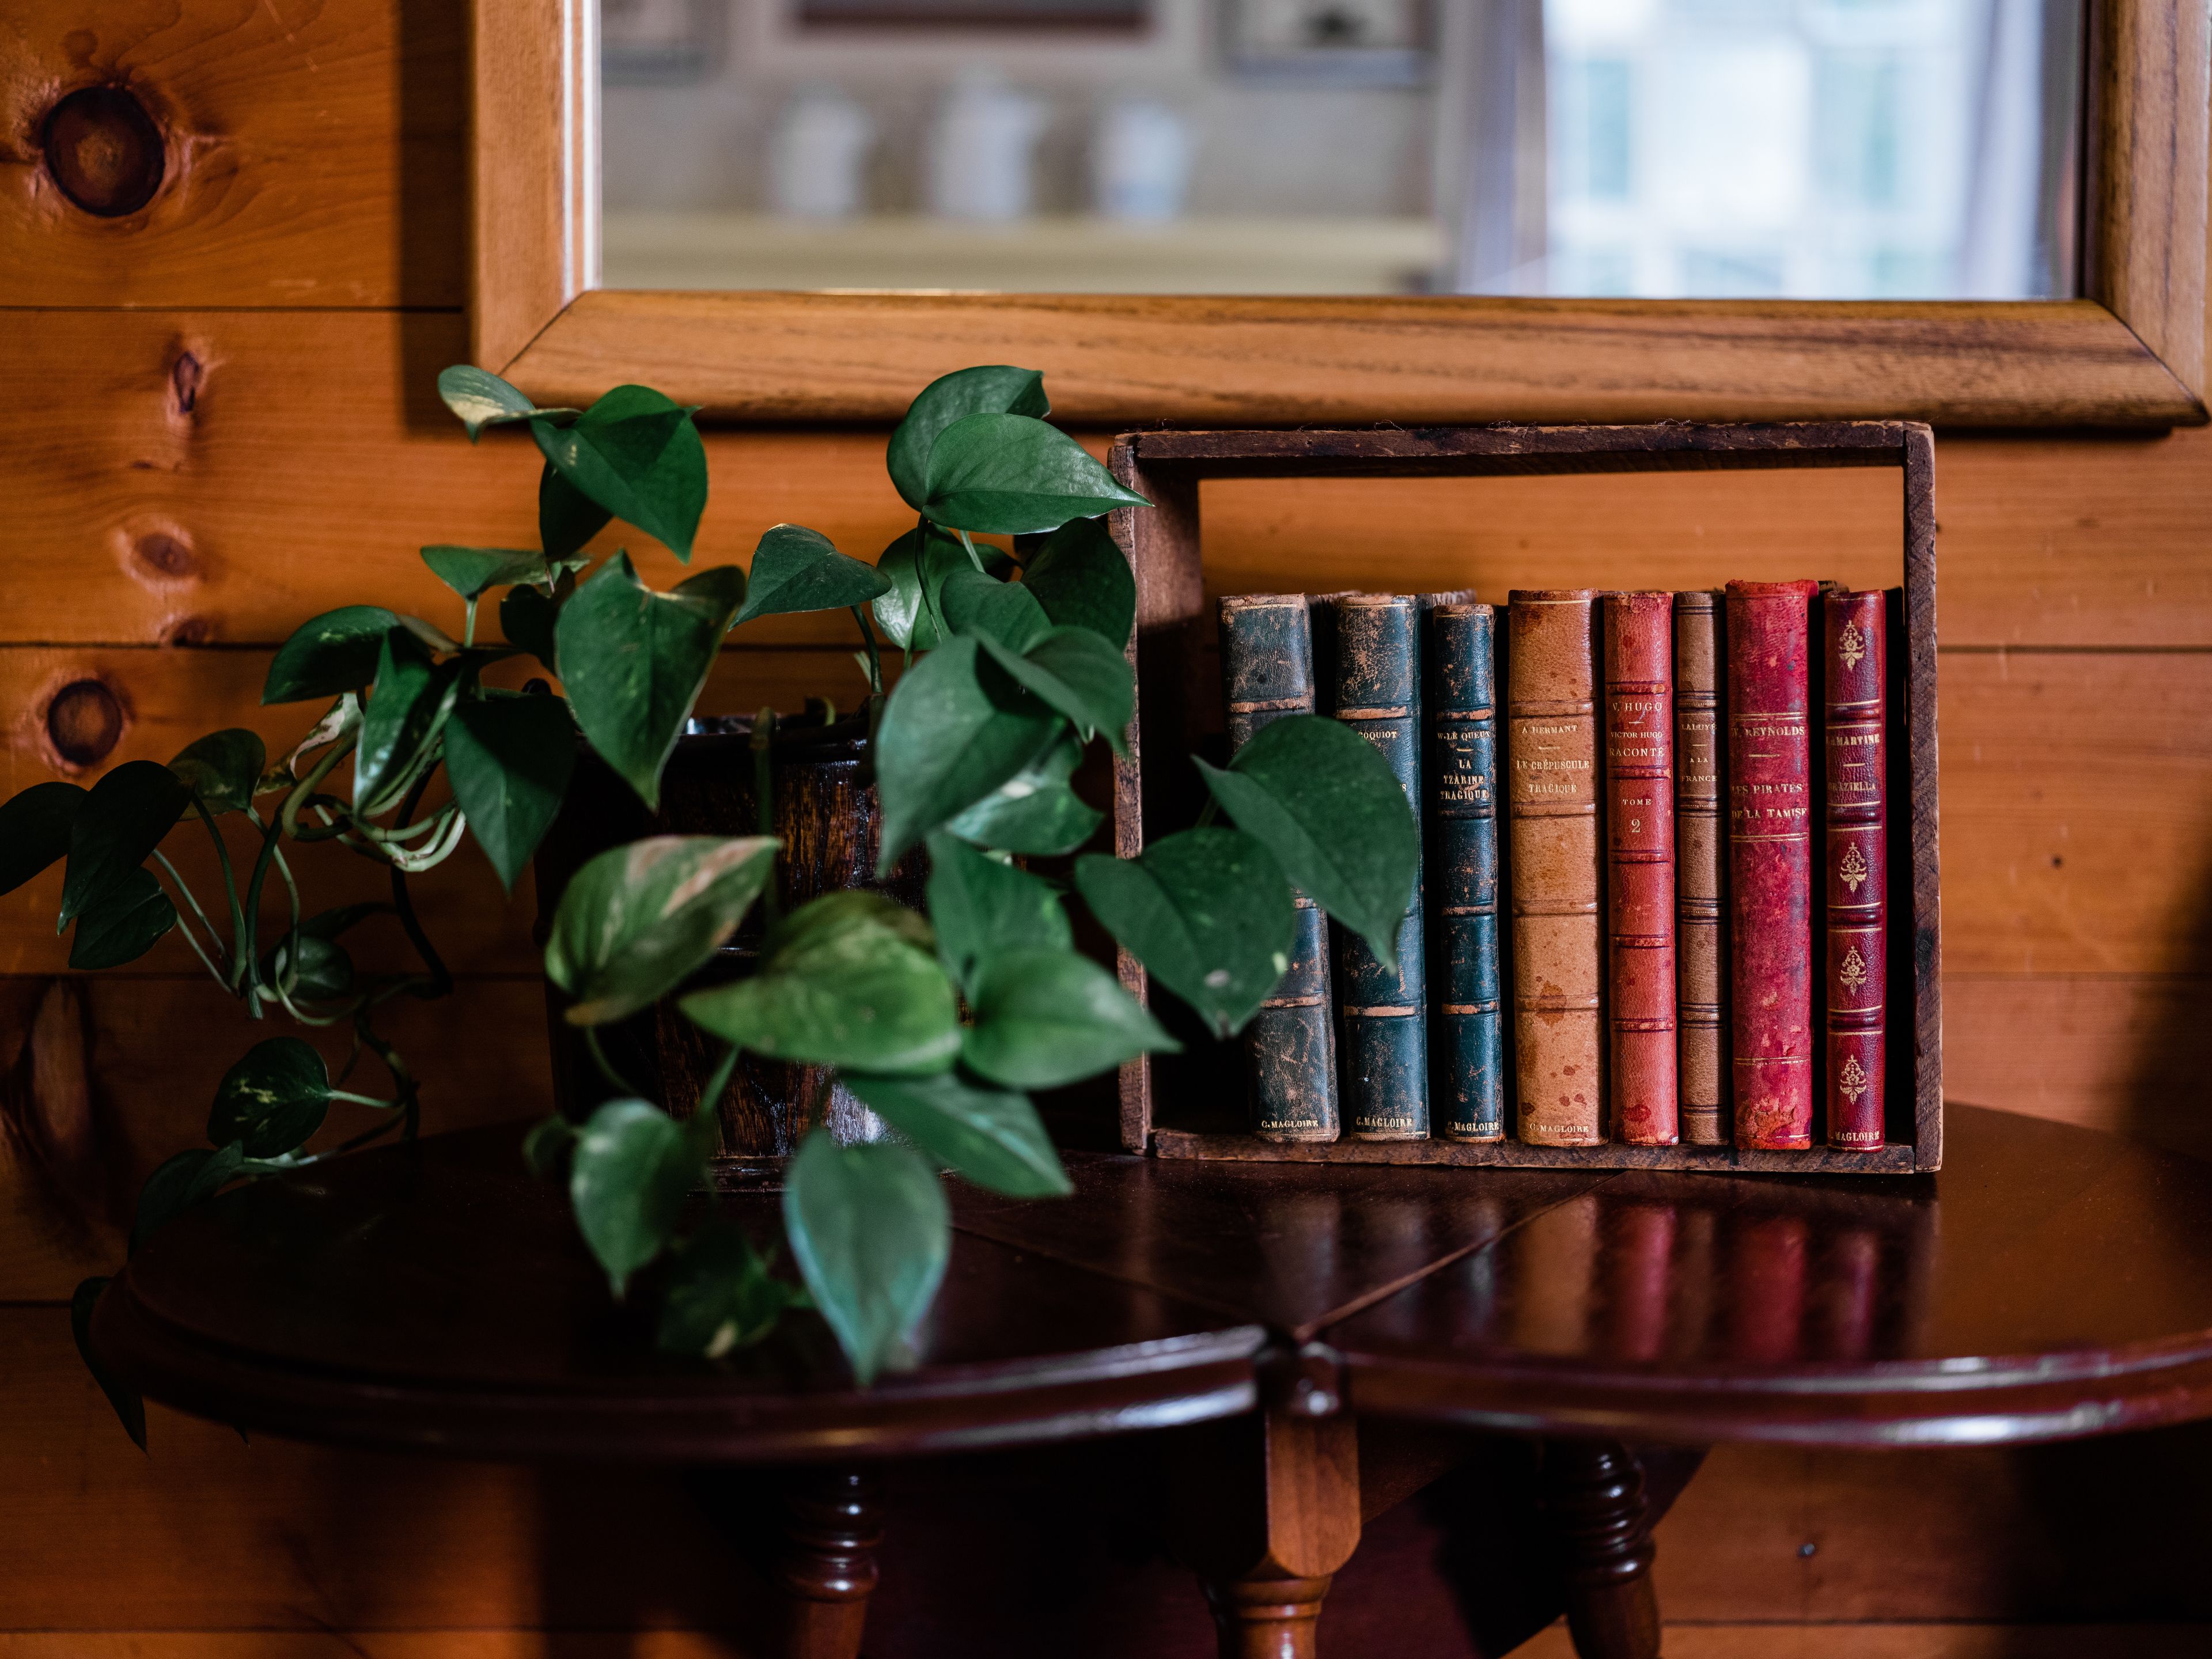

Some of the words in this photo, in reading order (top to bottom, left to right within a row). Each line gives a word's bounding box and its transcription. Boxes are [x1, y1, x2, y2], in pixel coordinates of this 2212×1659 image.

[1624, 702, 1662, 711] HUGO
[1532, 725, 1577, 734] HERMANT
[1745, 726, 1805, 737] REYNOLDS
[1461, 730, 1491, 741] QUEUX
[1826, 734, 1880, 746] LAMARTINE
[1609, 747, 1665, 756] RACONTÉ
[1459, 759, 1472, 769] LA
[1517, 760, 1527, 770] LE
[1532, 759, 1589, 770] CRÉPUSCULE
[1444, 775, 1484, 785] TZARINE
[1529, 784, 1577, 794] TRAGIQUE
[1732, 786, 1748, 794] LES
[1753, 783, 1802, 794] PIRATES
[1441, 790, 1490, 800] TRAGIQUE
[1732, 810, 1743, 819] DE
[1747, 809, 1761, 819] LA
[1631, 819, 1641, 833] 2
